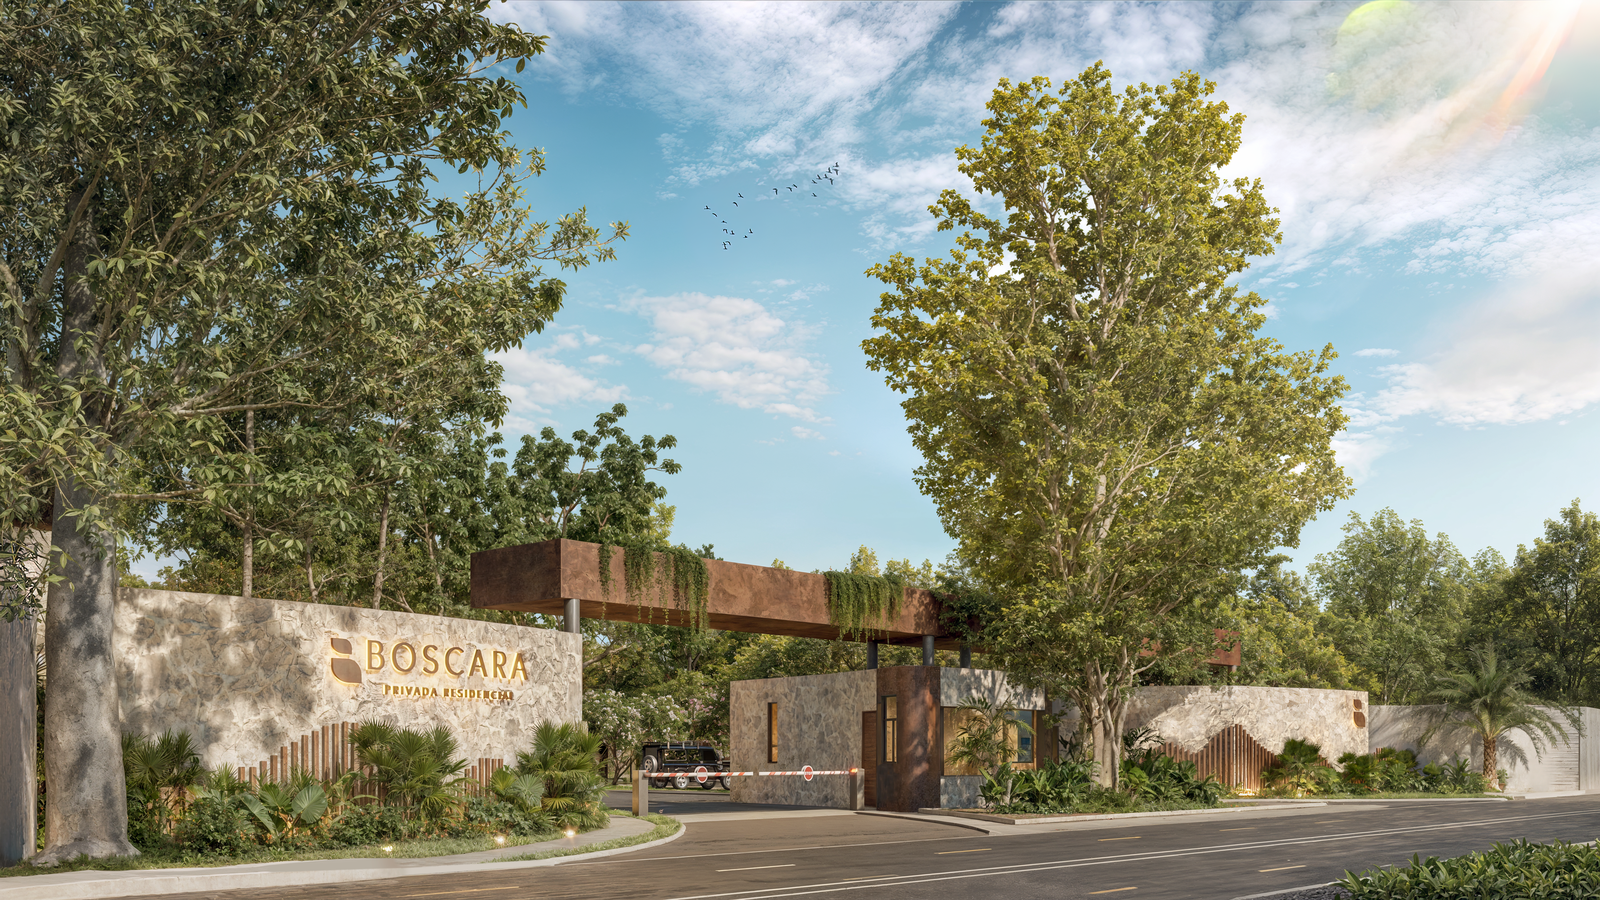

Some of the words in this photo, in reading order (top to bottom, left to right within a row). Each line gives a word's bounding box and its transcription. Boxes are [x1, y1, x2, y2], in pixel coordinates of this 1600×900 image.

[365, 638, 528, 681] BOSCARA
[382, 684, 438, 697] PRIVADA
[442, 688, 514, 701] RESIDENCIAL
